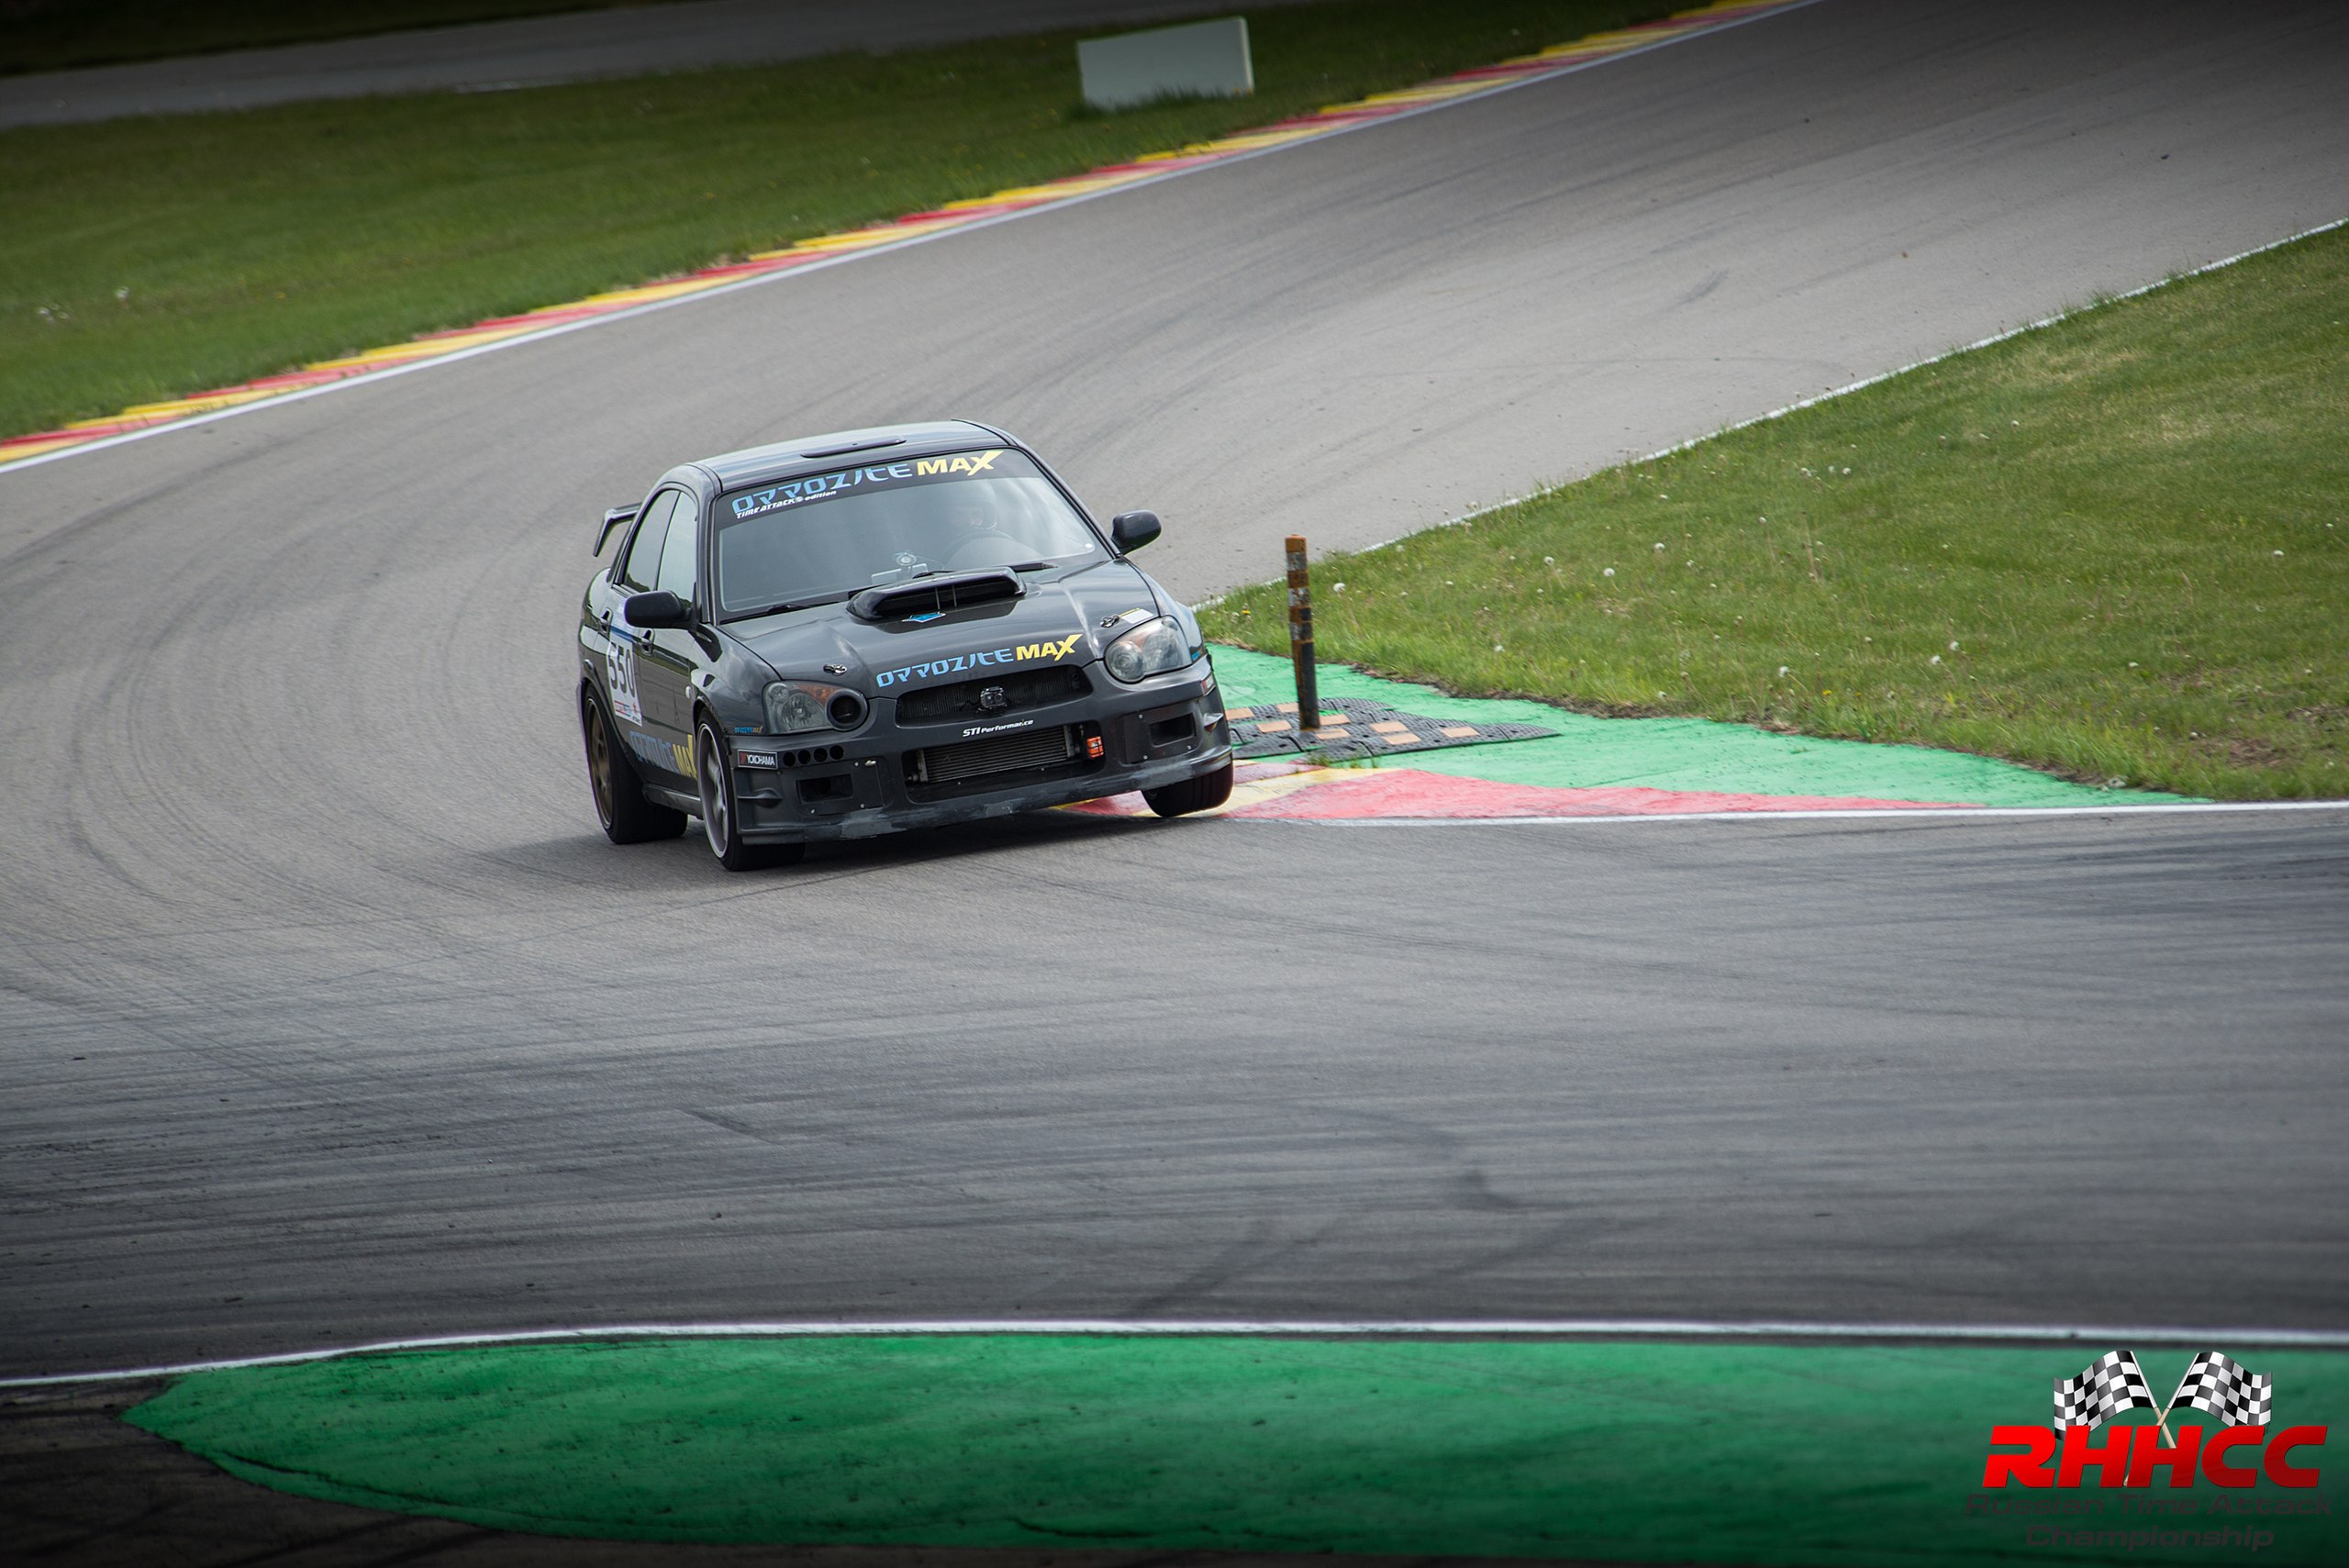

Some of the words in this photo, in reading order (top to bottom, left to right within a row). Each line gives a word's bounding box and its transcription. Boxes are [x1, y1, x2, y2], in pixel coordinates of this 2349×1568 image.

[917, 450, 1004, 476] MAX
[805, 490, 837, 501] edition
[1016, 633, 1083, 662] MAX
[607, 641, 636, 698] 550
[963, 727, 981, 738] STI
